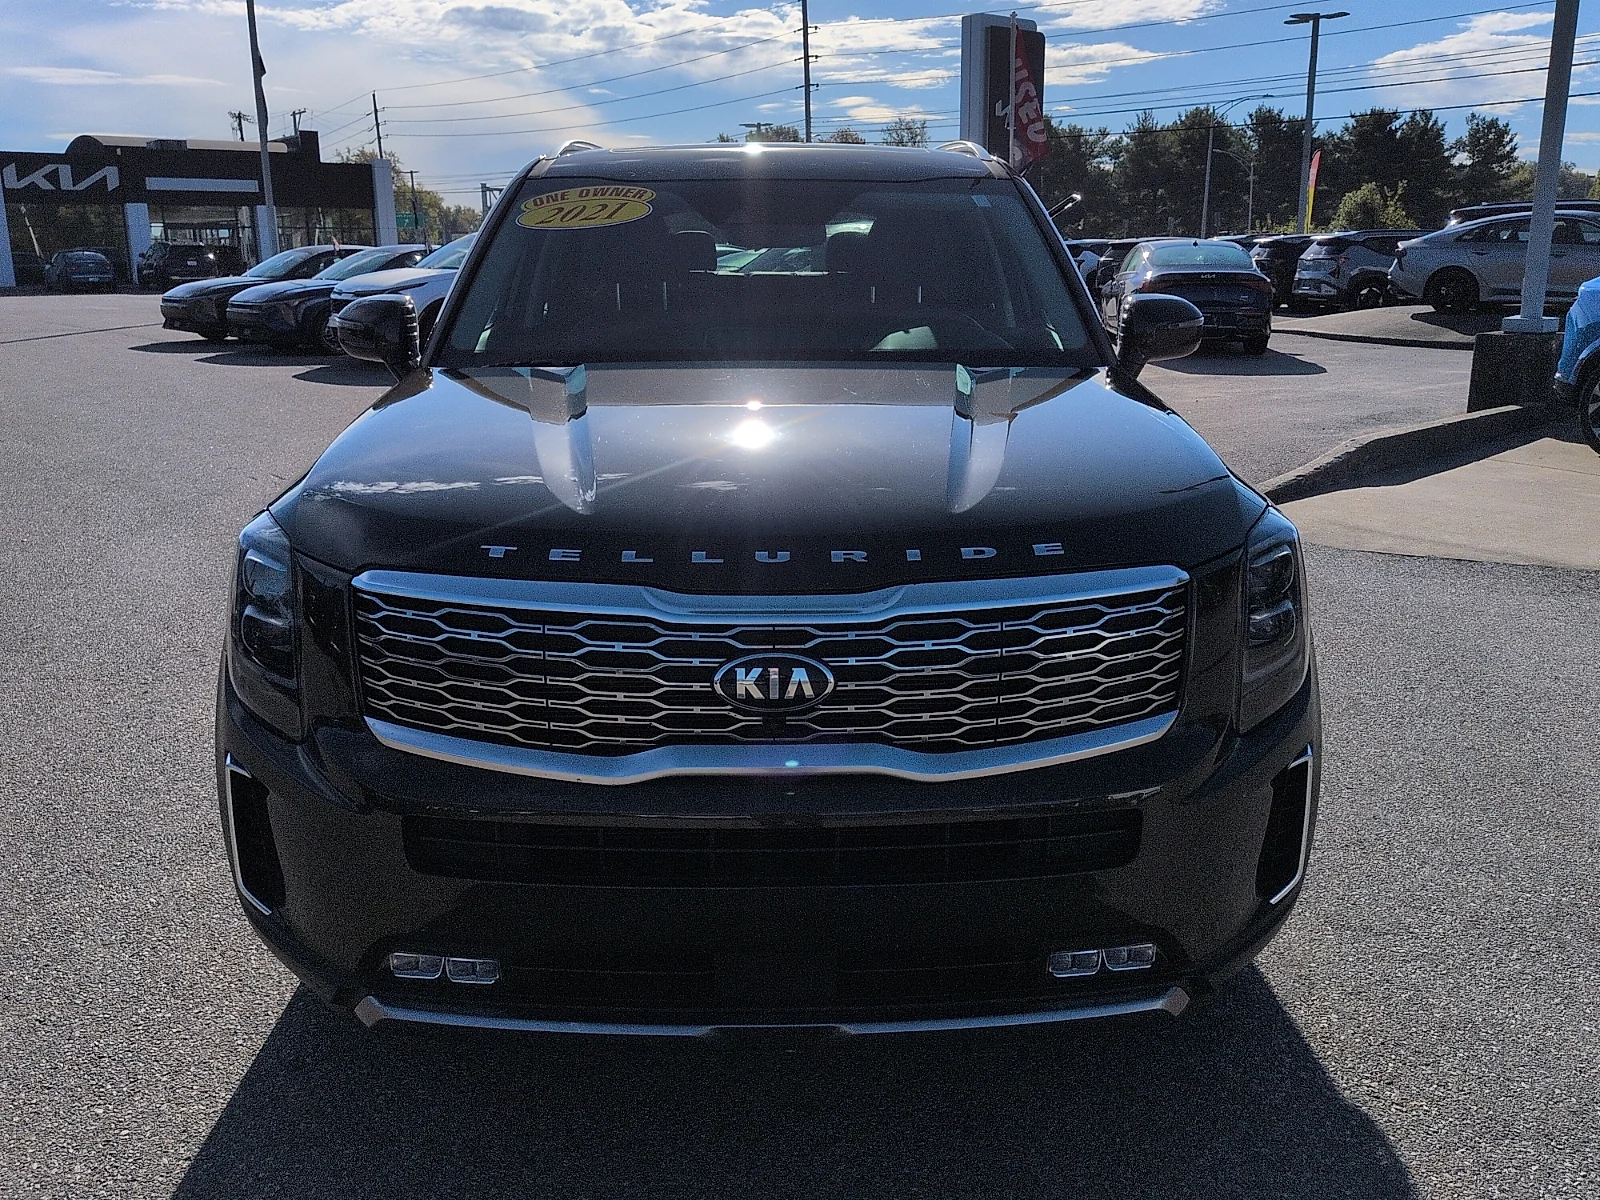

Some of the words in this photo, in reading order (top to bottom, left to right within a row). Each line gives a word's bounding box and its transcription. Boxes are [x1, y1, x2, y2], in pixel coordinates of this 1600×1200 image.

[2, 162, 120, 192] KIA
[532, 191, 570, 207] ONE
[578, 187, 649, 200] OWNER
[535, 202, 629, 225] 2021
[480, 543, 1065, 563] TELLURIDE
[735, 667, 815, 700] KIA
